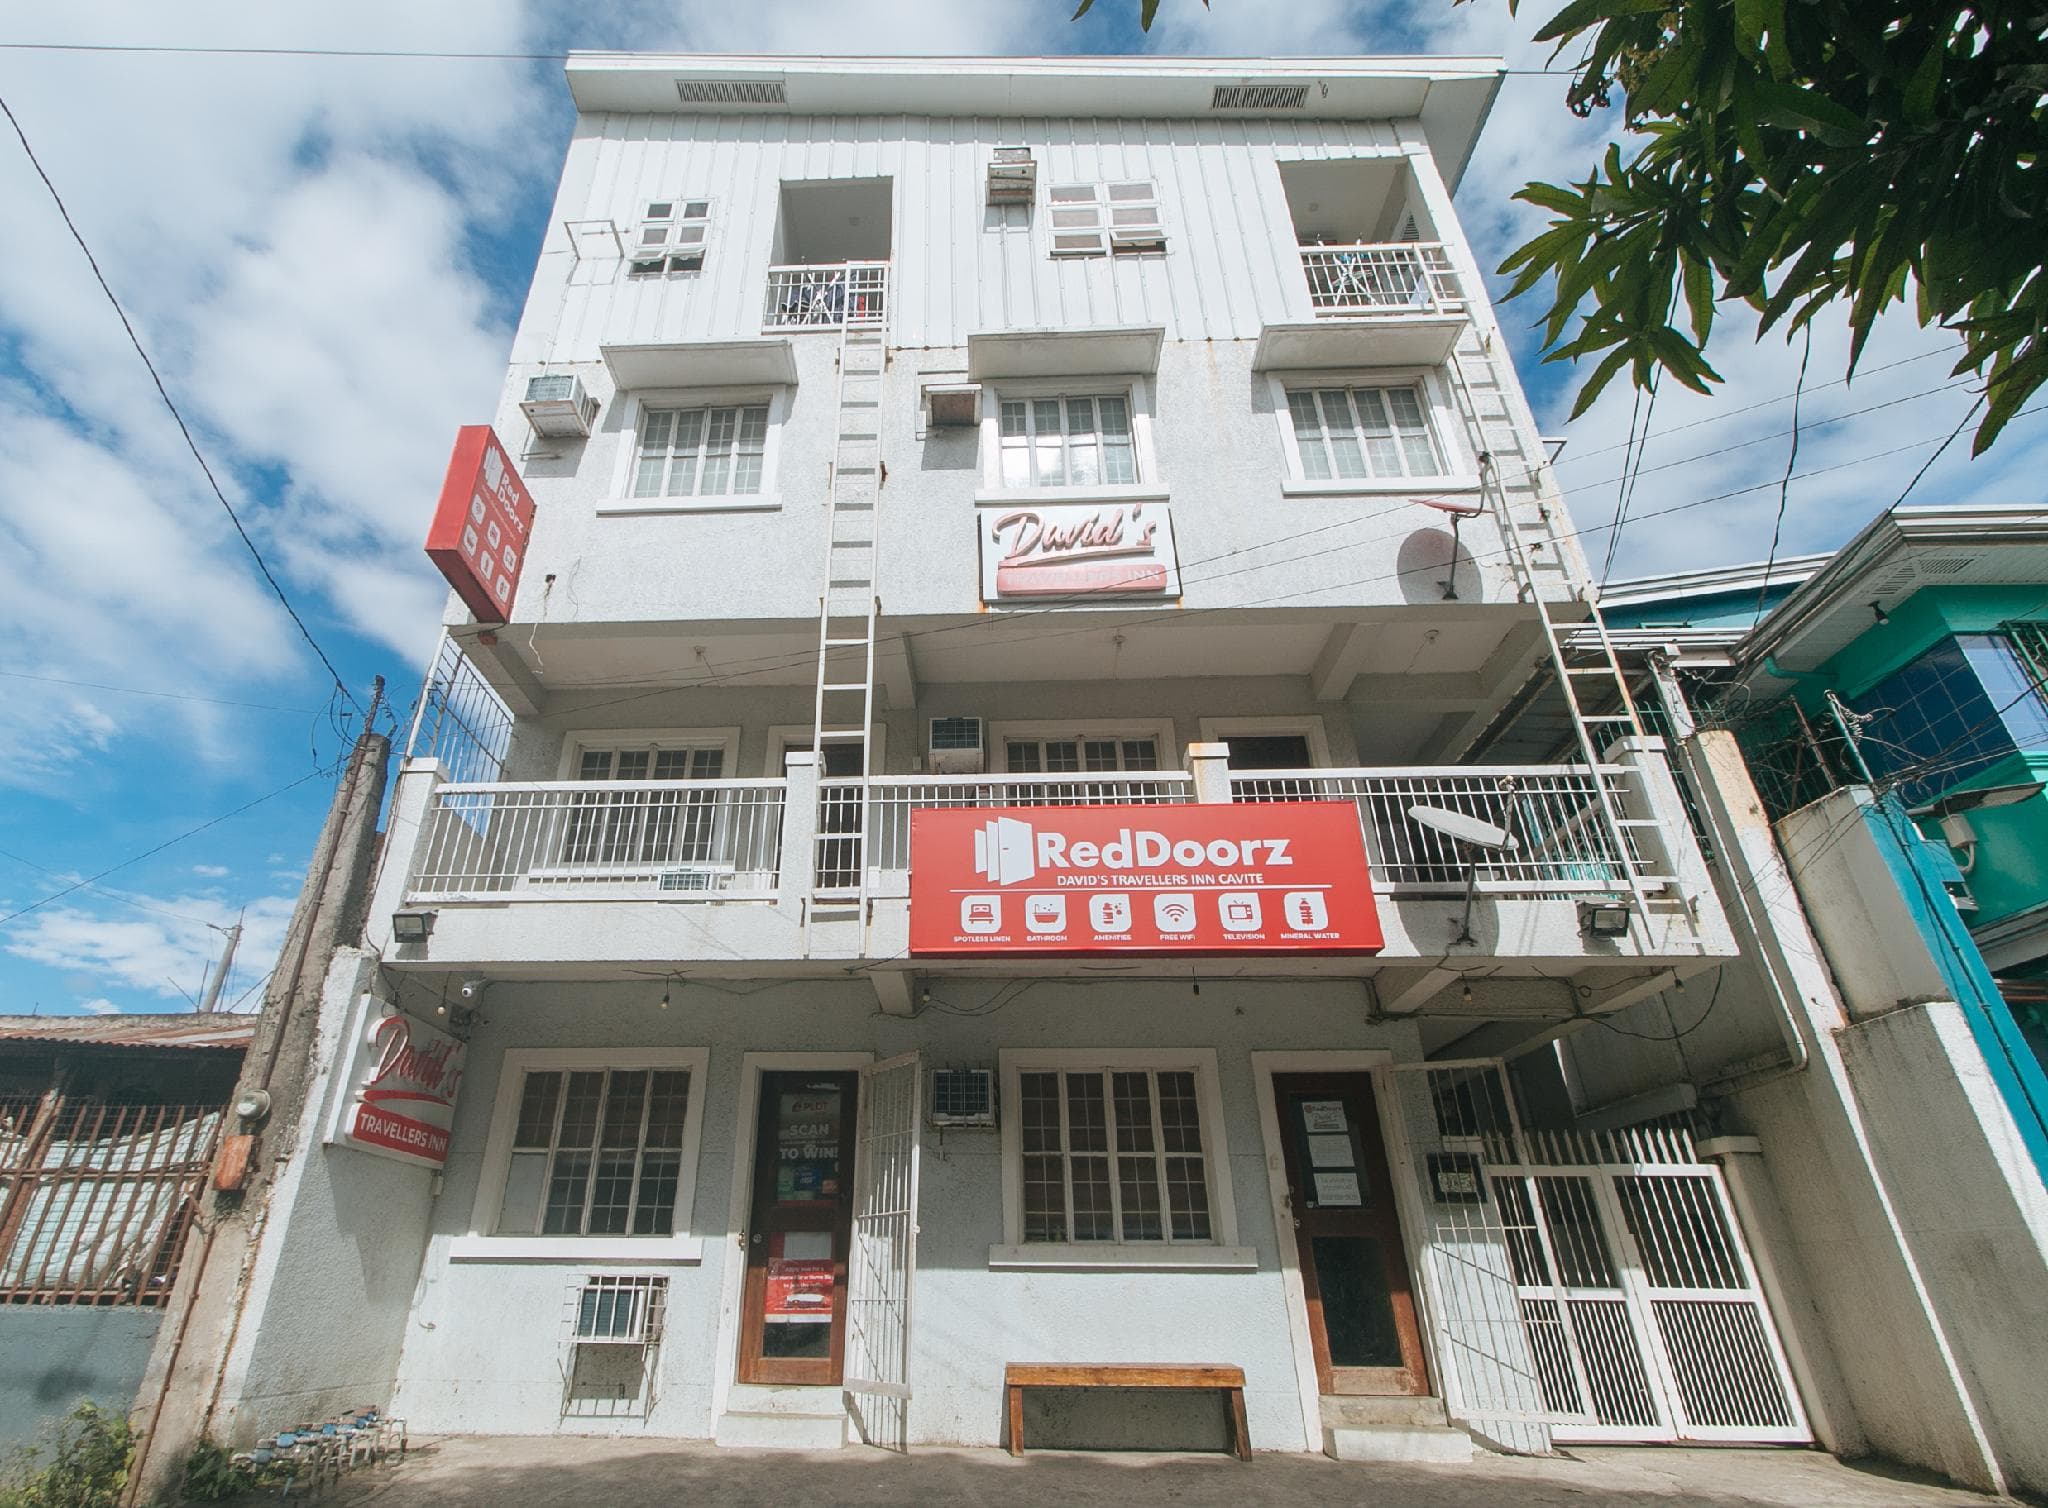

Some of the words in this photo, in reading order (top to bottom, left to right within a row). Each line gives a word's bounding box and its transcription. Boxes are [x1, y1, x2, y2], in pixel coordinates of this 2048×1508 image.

[501, 472, 520, 506] Red
[498, 485, 525, 534] Doorz
[992, 503, 1157, 560] David's
[1127, 568, 1160, 582] INN
[1037, 828, 1293, 869] RedDoorz
[1057, 874, 1109, 886] DAVID'S
[1111, 874, 1188, 886] TRAVELLERS
[1191, 873, 1215, 886] INN
[1217, 873, 1265, 885] CAVITE
[953, 935, 989, 943] SPOTLESS
[1026, 934, 1068, 942] BATHROOM
[1093, 934, 1132, 942] AMENITIES
[1159, 933, 1179, 941] FREE
[1222, 933, 1265, 941] TELEVISION
[1280, 932, 1312, 940] MINERAL
[1312, 931, 1340, 940] WATER
[365, 1015, 463, 1098] David's
[360, 1113, 428, 1147] TRAVELLERS
[428, 1134, 448, 1153] INN
[789, 1124, 830, 1137] SCAN
[779, 1147, 804, 1160] TO
[805, 1146, 839, 1159] WIN!
